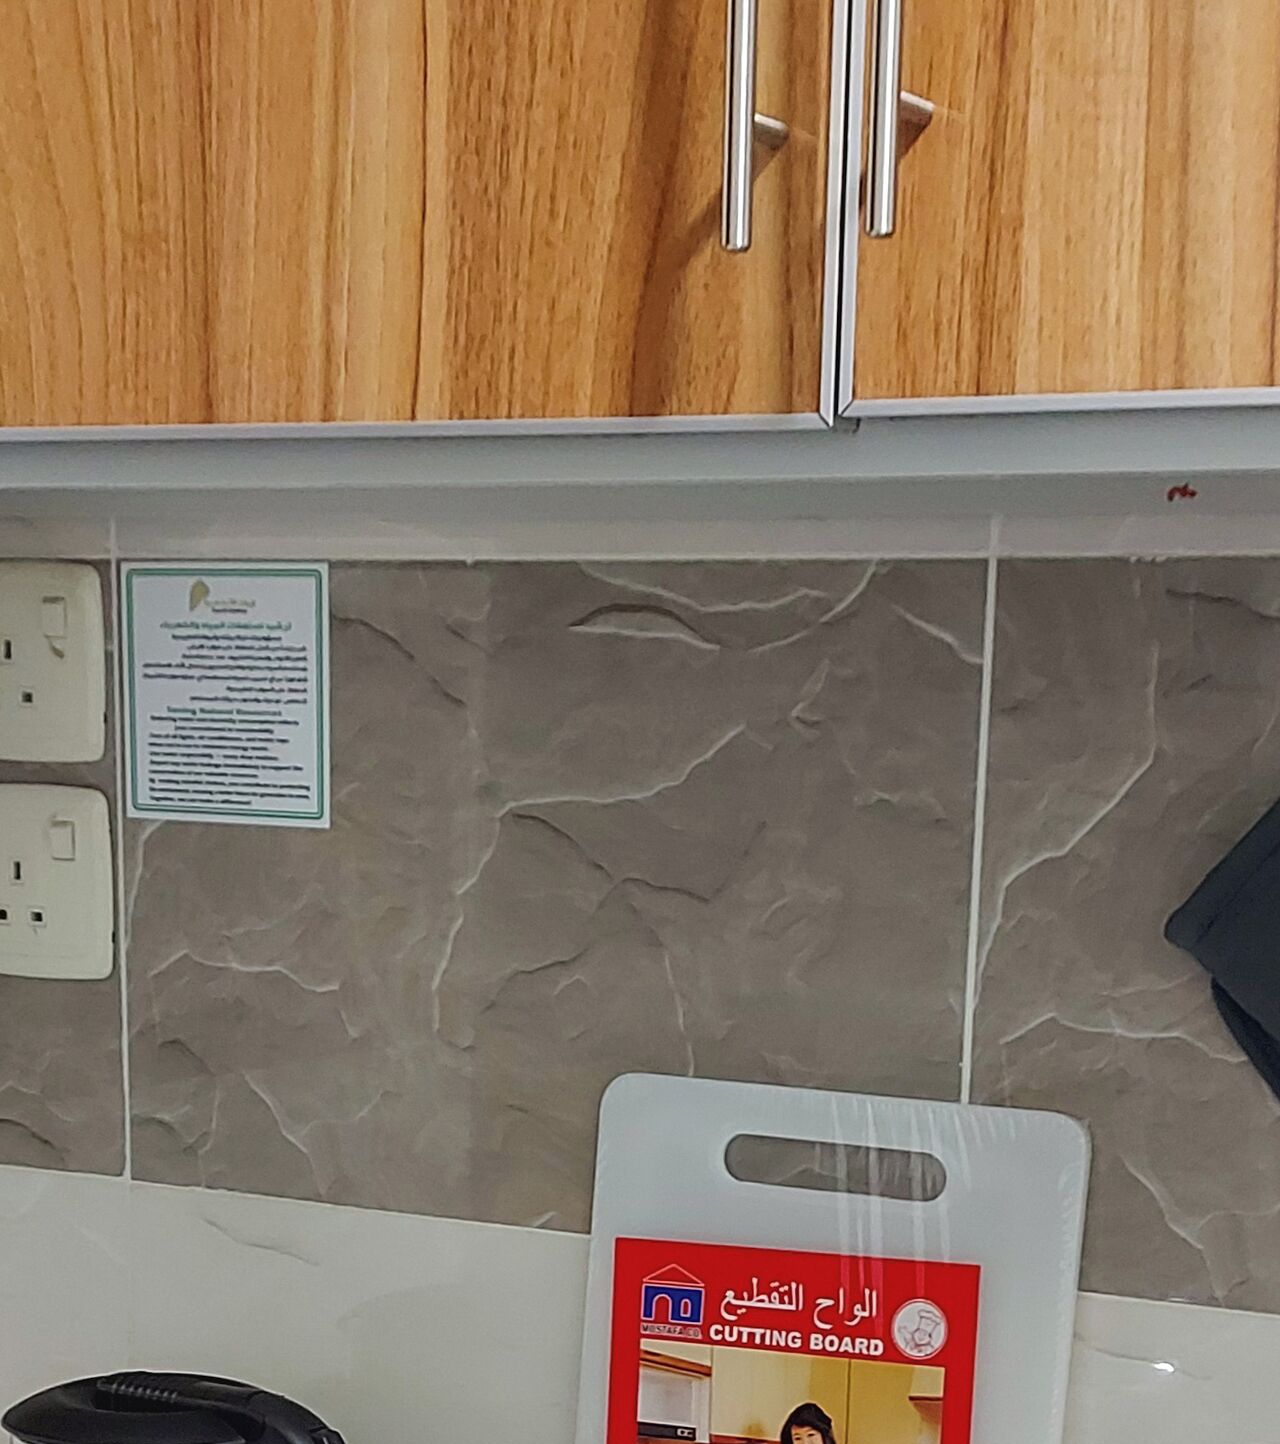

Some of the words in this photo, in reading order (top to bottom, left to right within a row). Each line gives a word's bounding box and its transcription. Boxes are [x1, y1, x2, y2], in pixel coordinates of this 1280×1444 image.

[721, 1277, 803, 1320] التقطيع
[813, 1287, 877, 1329] الواح
[709, 1324, 802, 1349] CUTTING
[809, 1333, 885, 1356] BOARD
